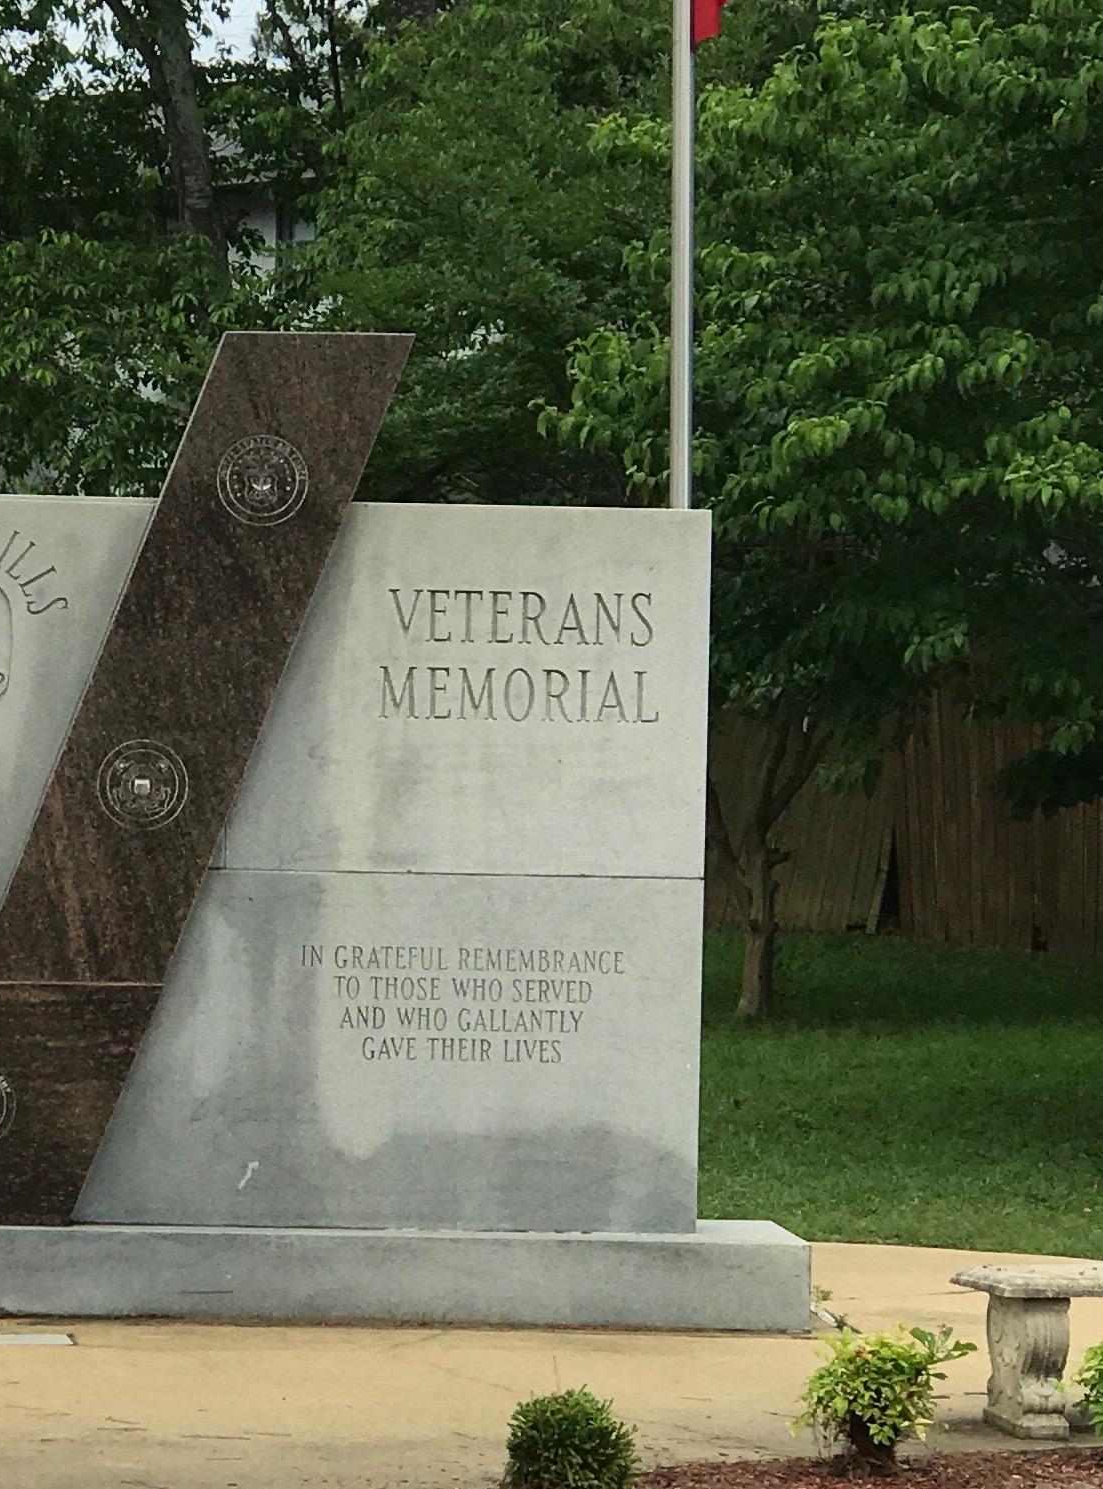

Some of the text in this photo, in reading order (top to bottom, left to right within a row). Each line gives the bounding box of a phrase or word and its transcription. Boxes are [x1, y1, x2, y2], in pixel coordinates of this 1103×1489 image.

[388, 587, 654, 647] VETERANS
[377, 665, 660, 723] MEMORIAL
[300, 944, 625, 975] IN GRATEFUL REMEMBRANCE
[334, 975, 594, 1004] TO THOSE WHO SERVED
[339, 1006, 584, 1033] AND WHO GALLANTLY
[362, 1036, 562, 1064] GAVE THEIR LIVES
